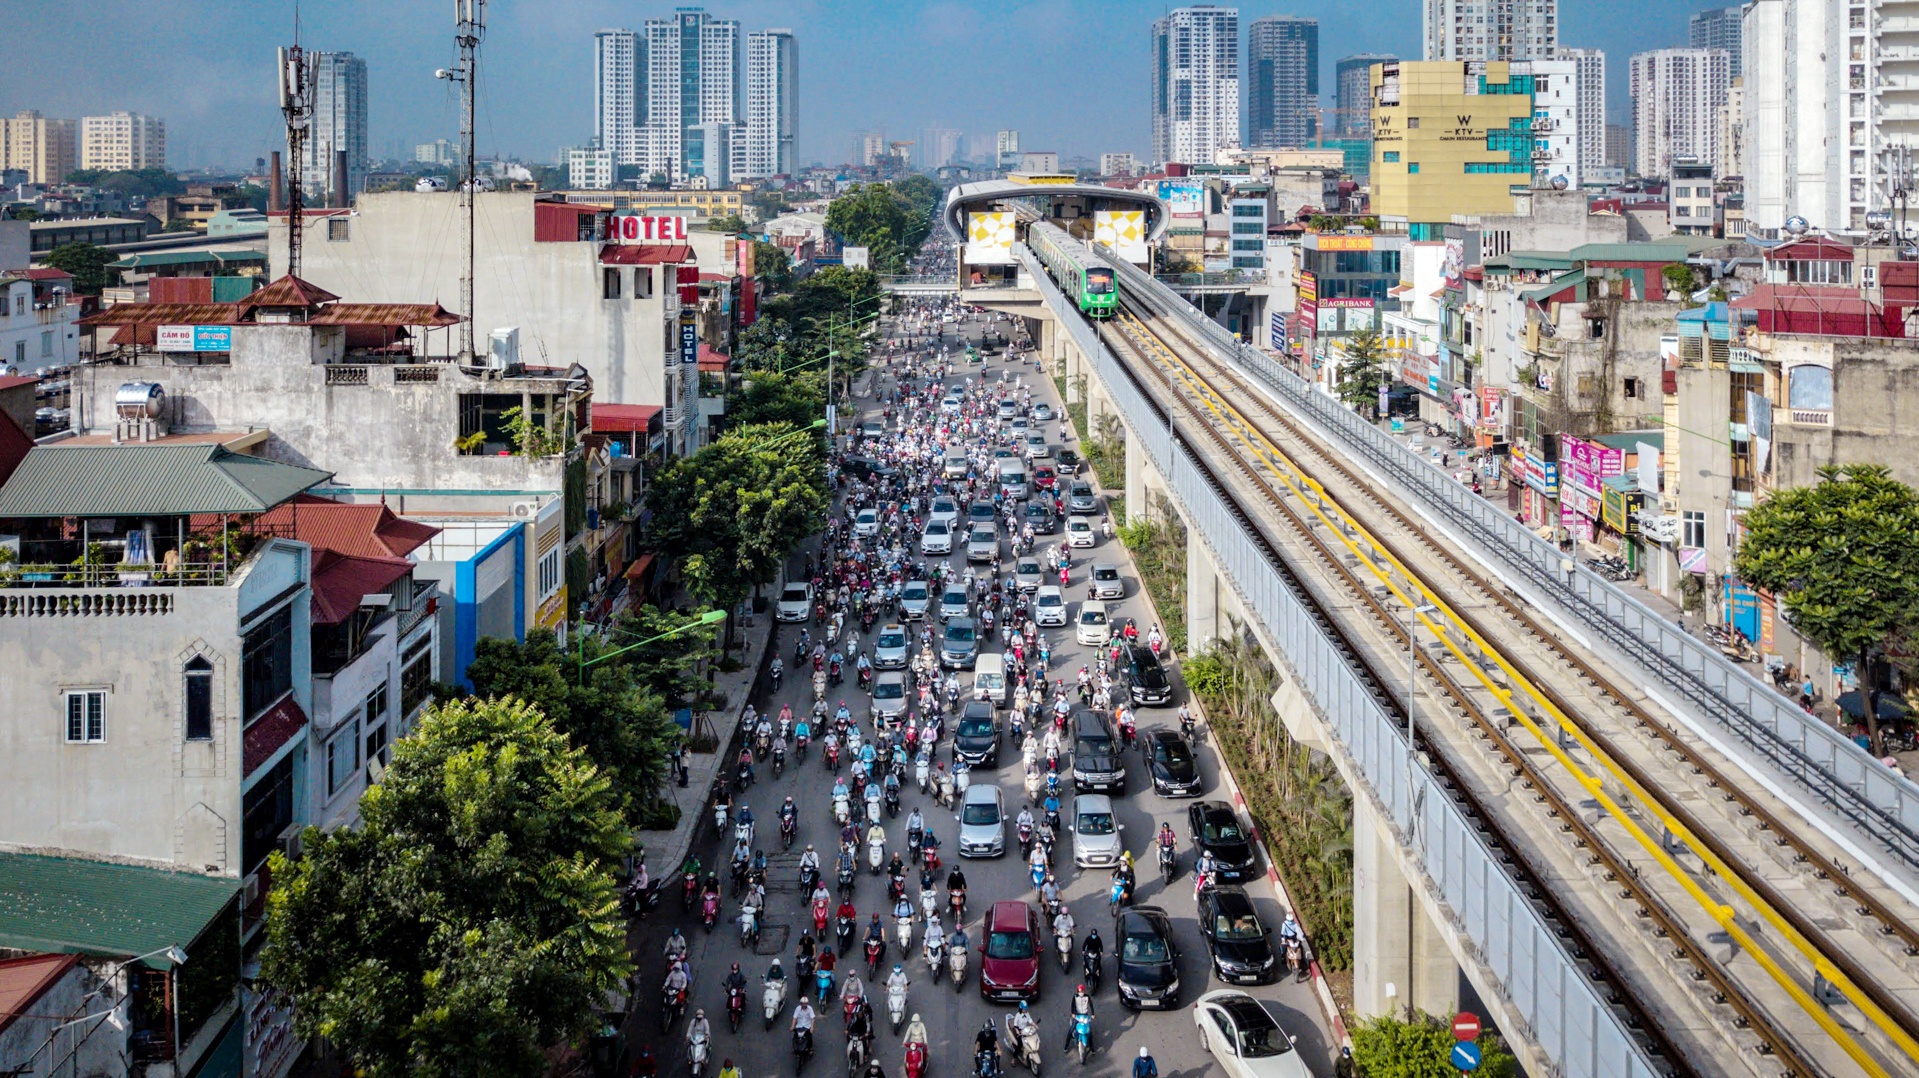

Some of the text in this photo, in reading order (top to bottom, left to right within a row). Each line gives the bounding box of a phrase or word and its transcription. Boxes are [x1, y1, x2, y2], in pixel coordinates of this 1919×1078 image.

[1380, 116, 1391, 126] W
[1457, 115, 1472, 126] W
[605, 216, 687, 239] HOTEL
[683, 326, 694, 362] HOTEL
